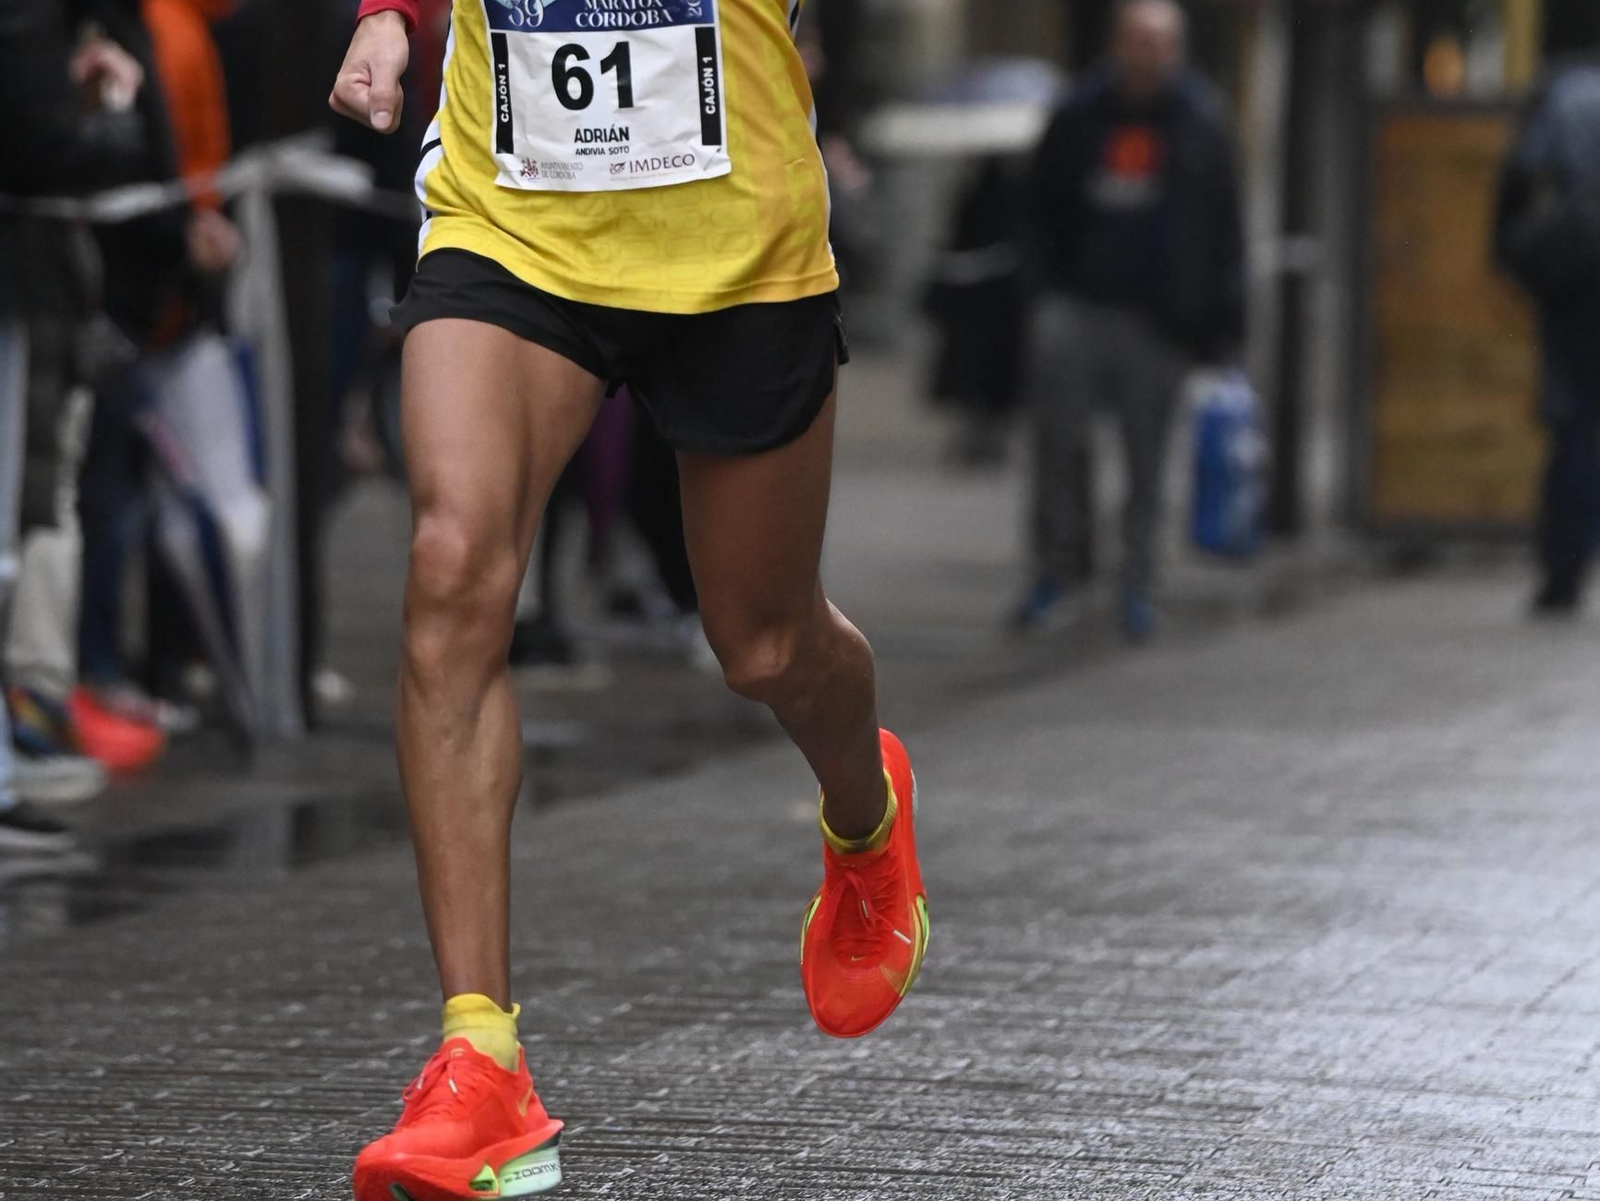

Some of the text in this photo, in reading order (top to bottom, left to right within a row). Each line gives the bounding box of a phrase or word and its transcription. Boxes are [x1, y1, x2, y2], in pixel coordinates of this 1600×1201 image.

[575, 8, 673, 28] CÓRDOBA
[551, 41, 634, 111] 61
[702, 56, 716, 115] CAJÓN 1
[499, 75, 510, 123] CAJÓN
[574, 123, 630, 143] ADRIÁN
[575, 145, 630, 156] ANDIVIA SOTO
[629, 153, 695, 173] IMDECO
